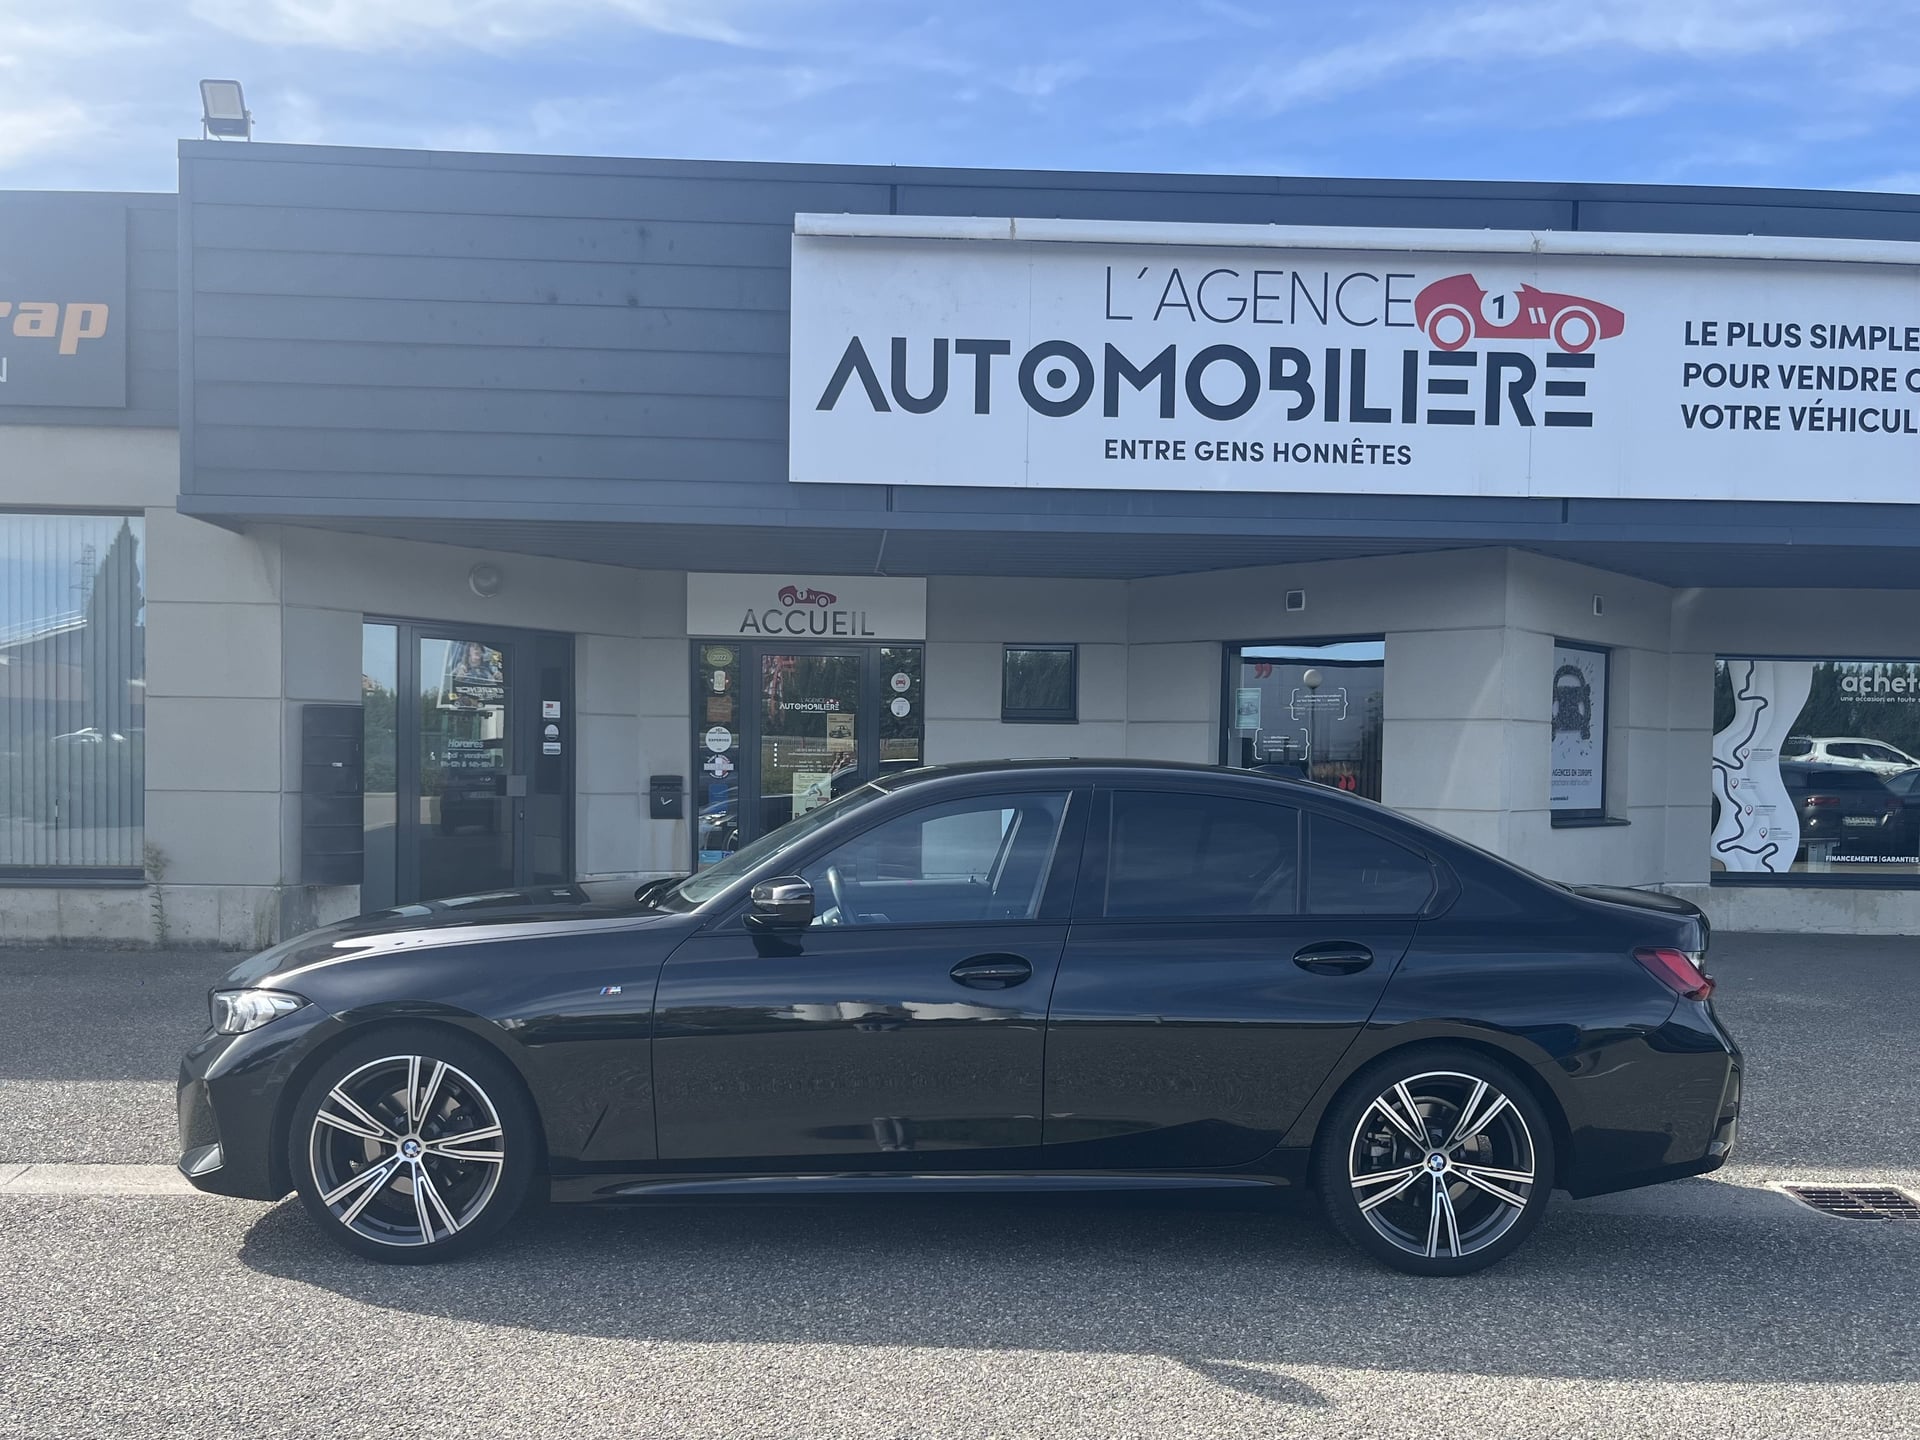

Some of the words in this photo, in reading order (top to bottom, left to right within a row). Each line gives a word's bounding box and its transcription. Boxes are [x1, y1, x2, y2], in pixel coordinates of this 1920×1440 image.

[1105, 265, 1415, 327] L'AGENCE
[1492, 294, 1505, 320] 1
[1684, 320, 1718, 346] LE
[1727, 322, 1802, 349] PLUS
[1809, 324, 1920, 352] SIMPLE
[1683, 362, 1770, 389] POUR
[1778, 364, 1898, 393] VENDRE
[1681, 403, 1781, 431] VOTRE
[1788, 398, 1920, 434] VÉHICUL
[1104, 439, 1186, 461] ENTRE
[1194, 440, 1265, 462] GENS
[1273, 438, 1412, 465] HONNÊTES
[739, 608, 875, 636] ACCUEIL
[1841, 667, 1920, 693] achet
[1825, 855, 1878, 863] FINANCEMENTS
[1881, 855, 1919, 863] GARANTIES
